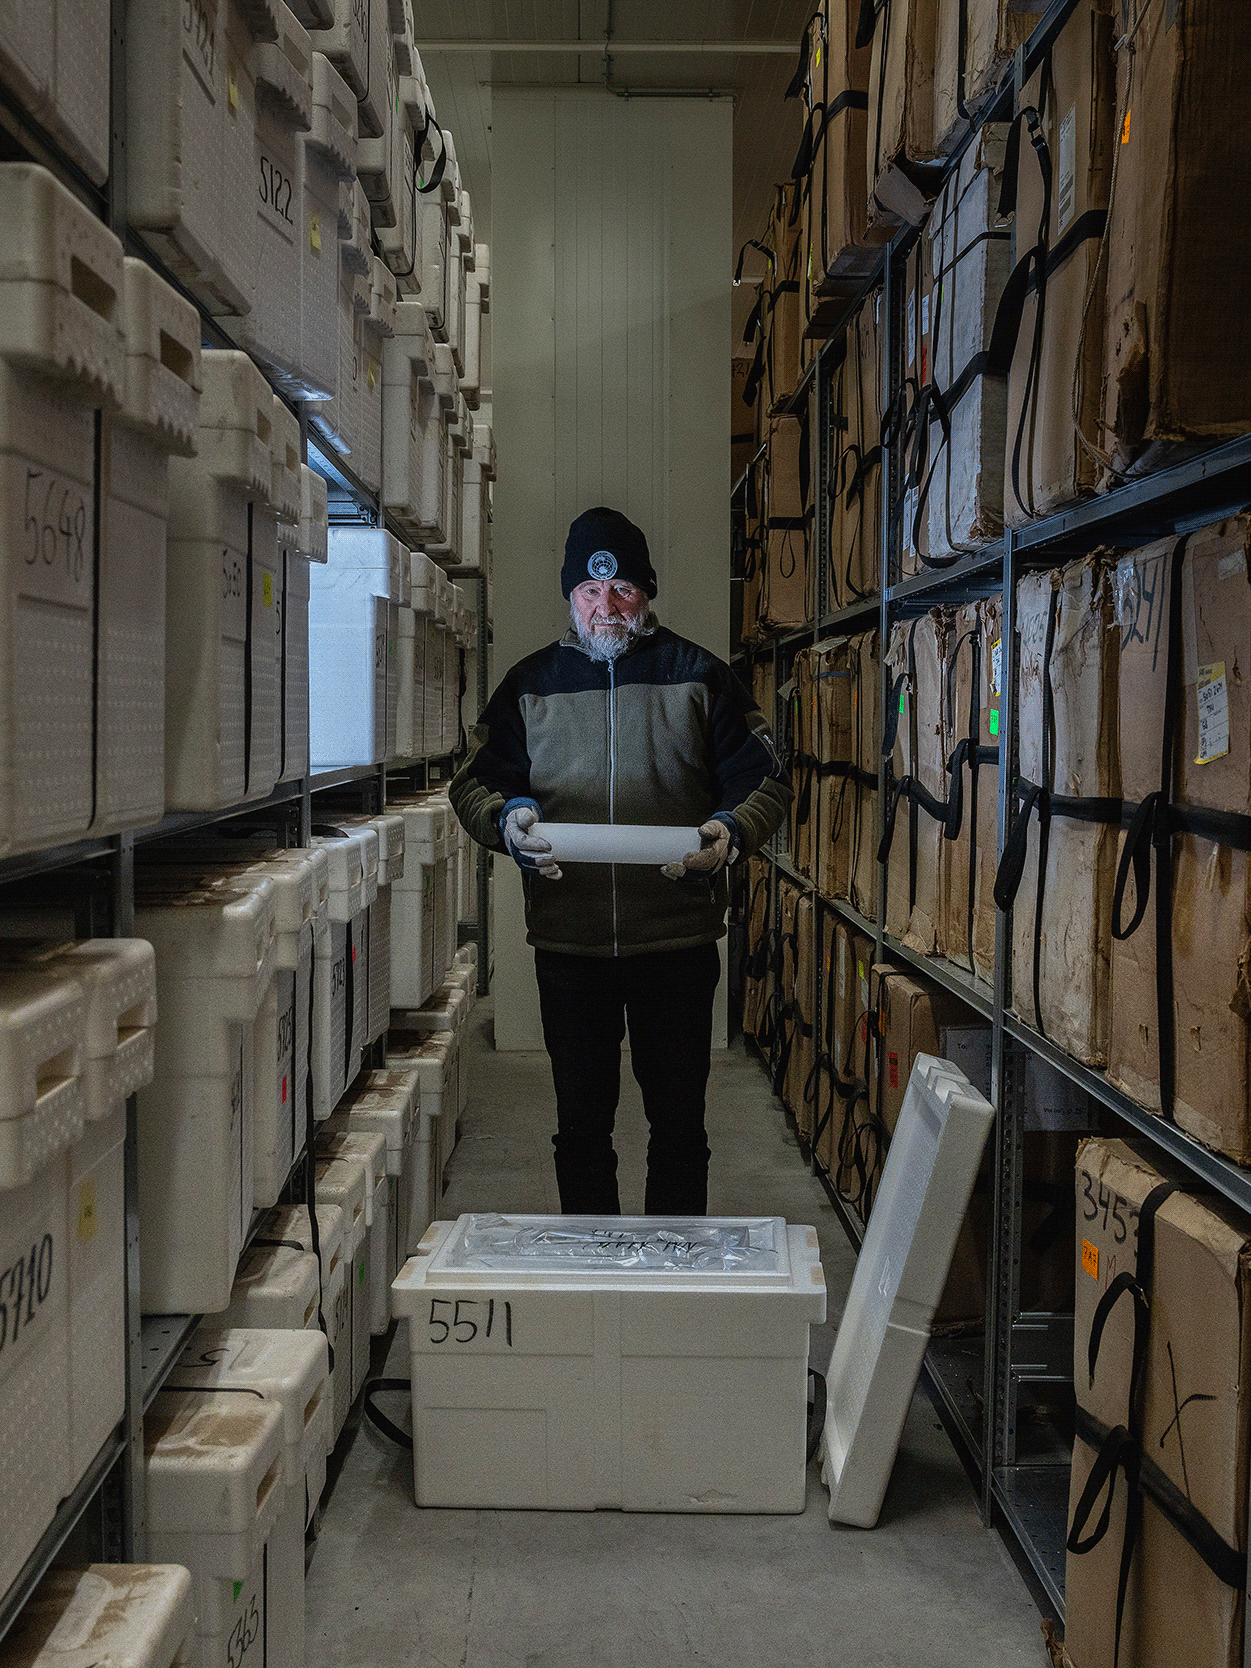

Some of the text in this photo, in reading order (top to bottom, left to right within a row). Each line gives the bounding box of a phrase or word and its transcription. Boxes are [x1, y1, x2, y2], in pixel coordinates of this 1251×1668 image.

[258, 156, 294, 226] 5122
[24, 466, 87, 583] 5648
[428, 1299, 513, 1347] 5511
